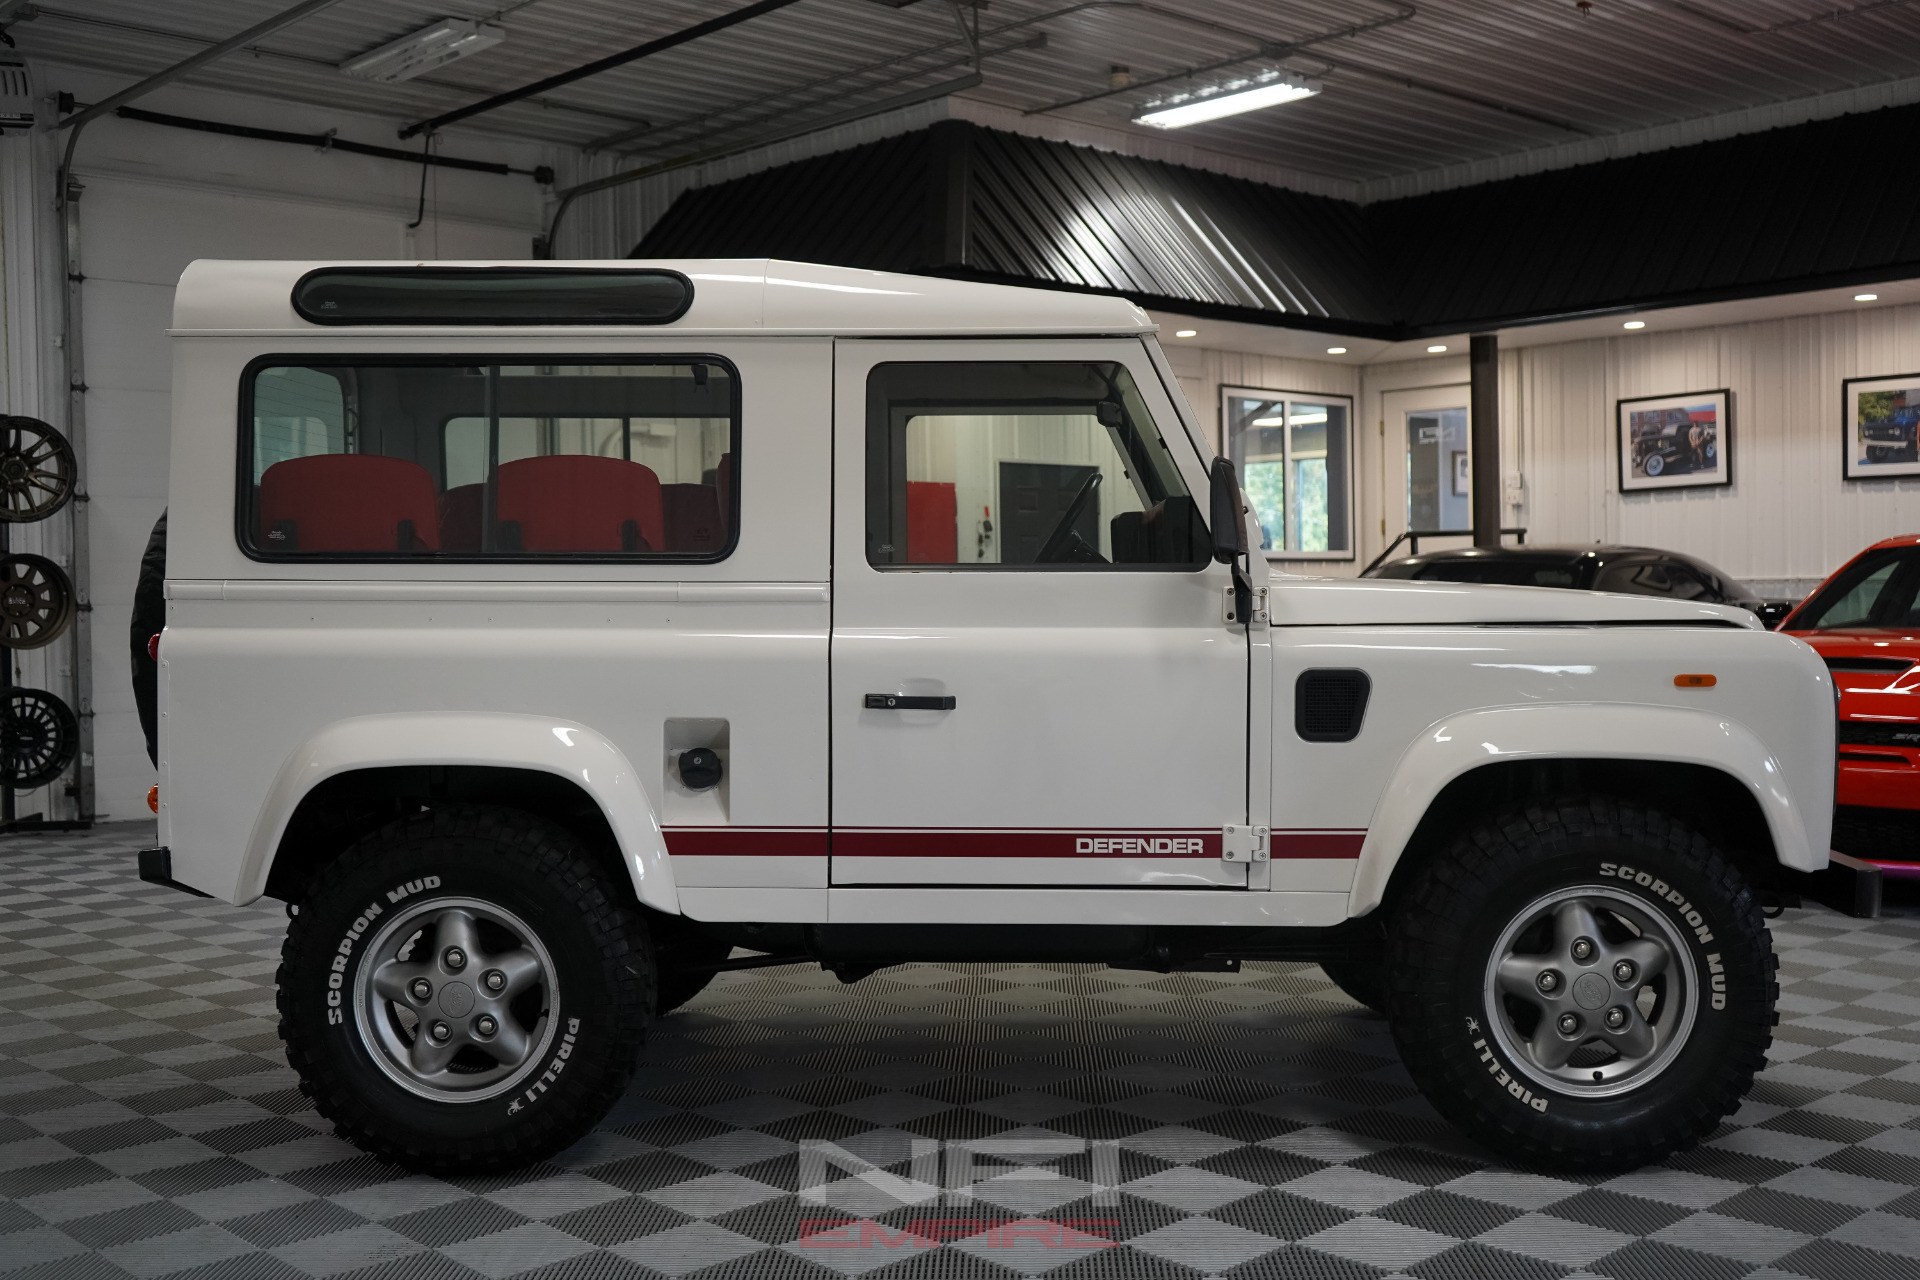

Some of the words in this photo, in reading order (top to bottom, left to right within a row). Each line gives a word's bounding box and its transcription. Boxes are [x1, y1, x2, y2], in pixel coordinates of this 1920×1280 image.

[1075, 838, 1204, 854] DEFENDER
[327, 902, 384, 1025] SCORPION
[386, 875, 441, 904] MUD
[1599, 862, 1714, 945] SCORPION
[1706, 953, 1727, 1011] MUD
[525, 1017, 581, 1103] PIRELLI
[1473, 1038, 1549, 1113] PIRELLI
